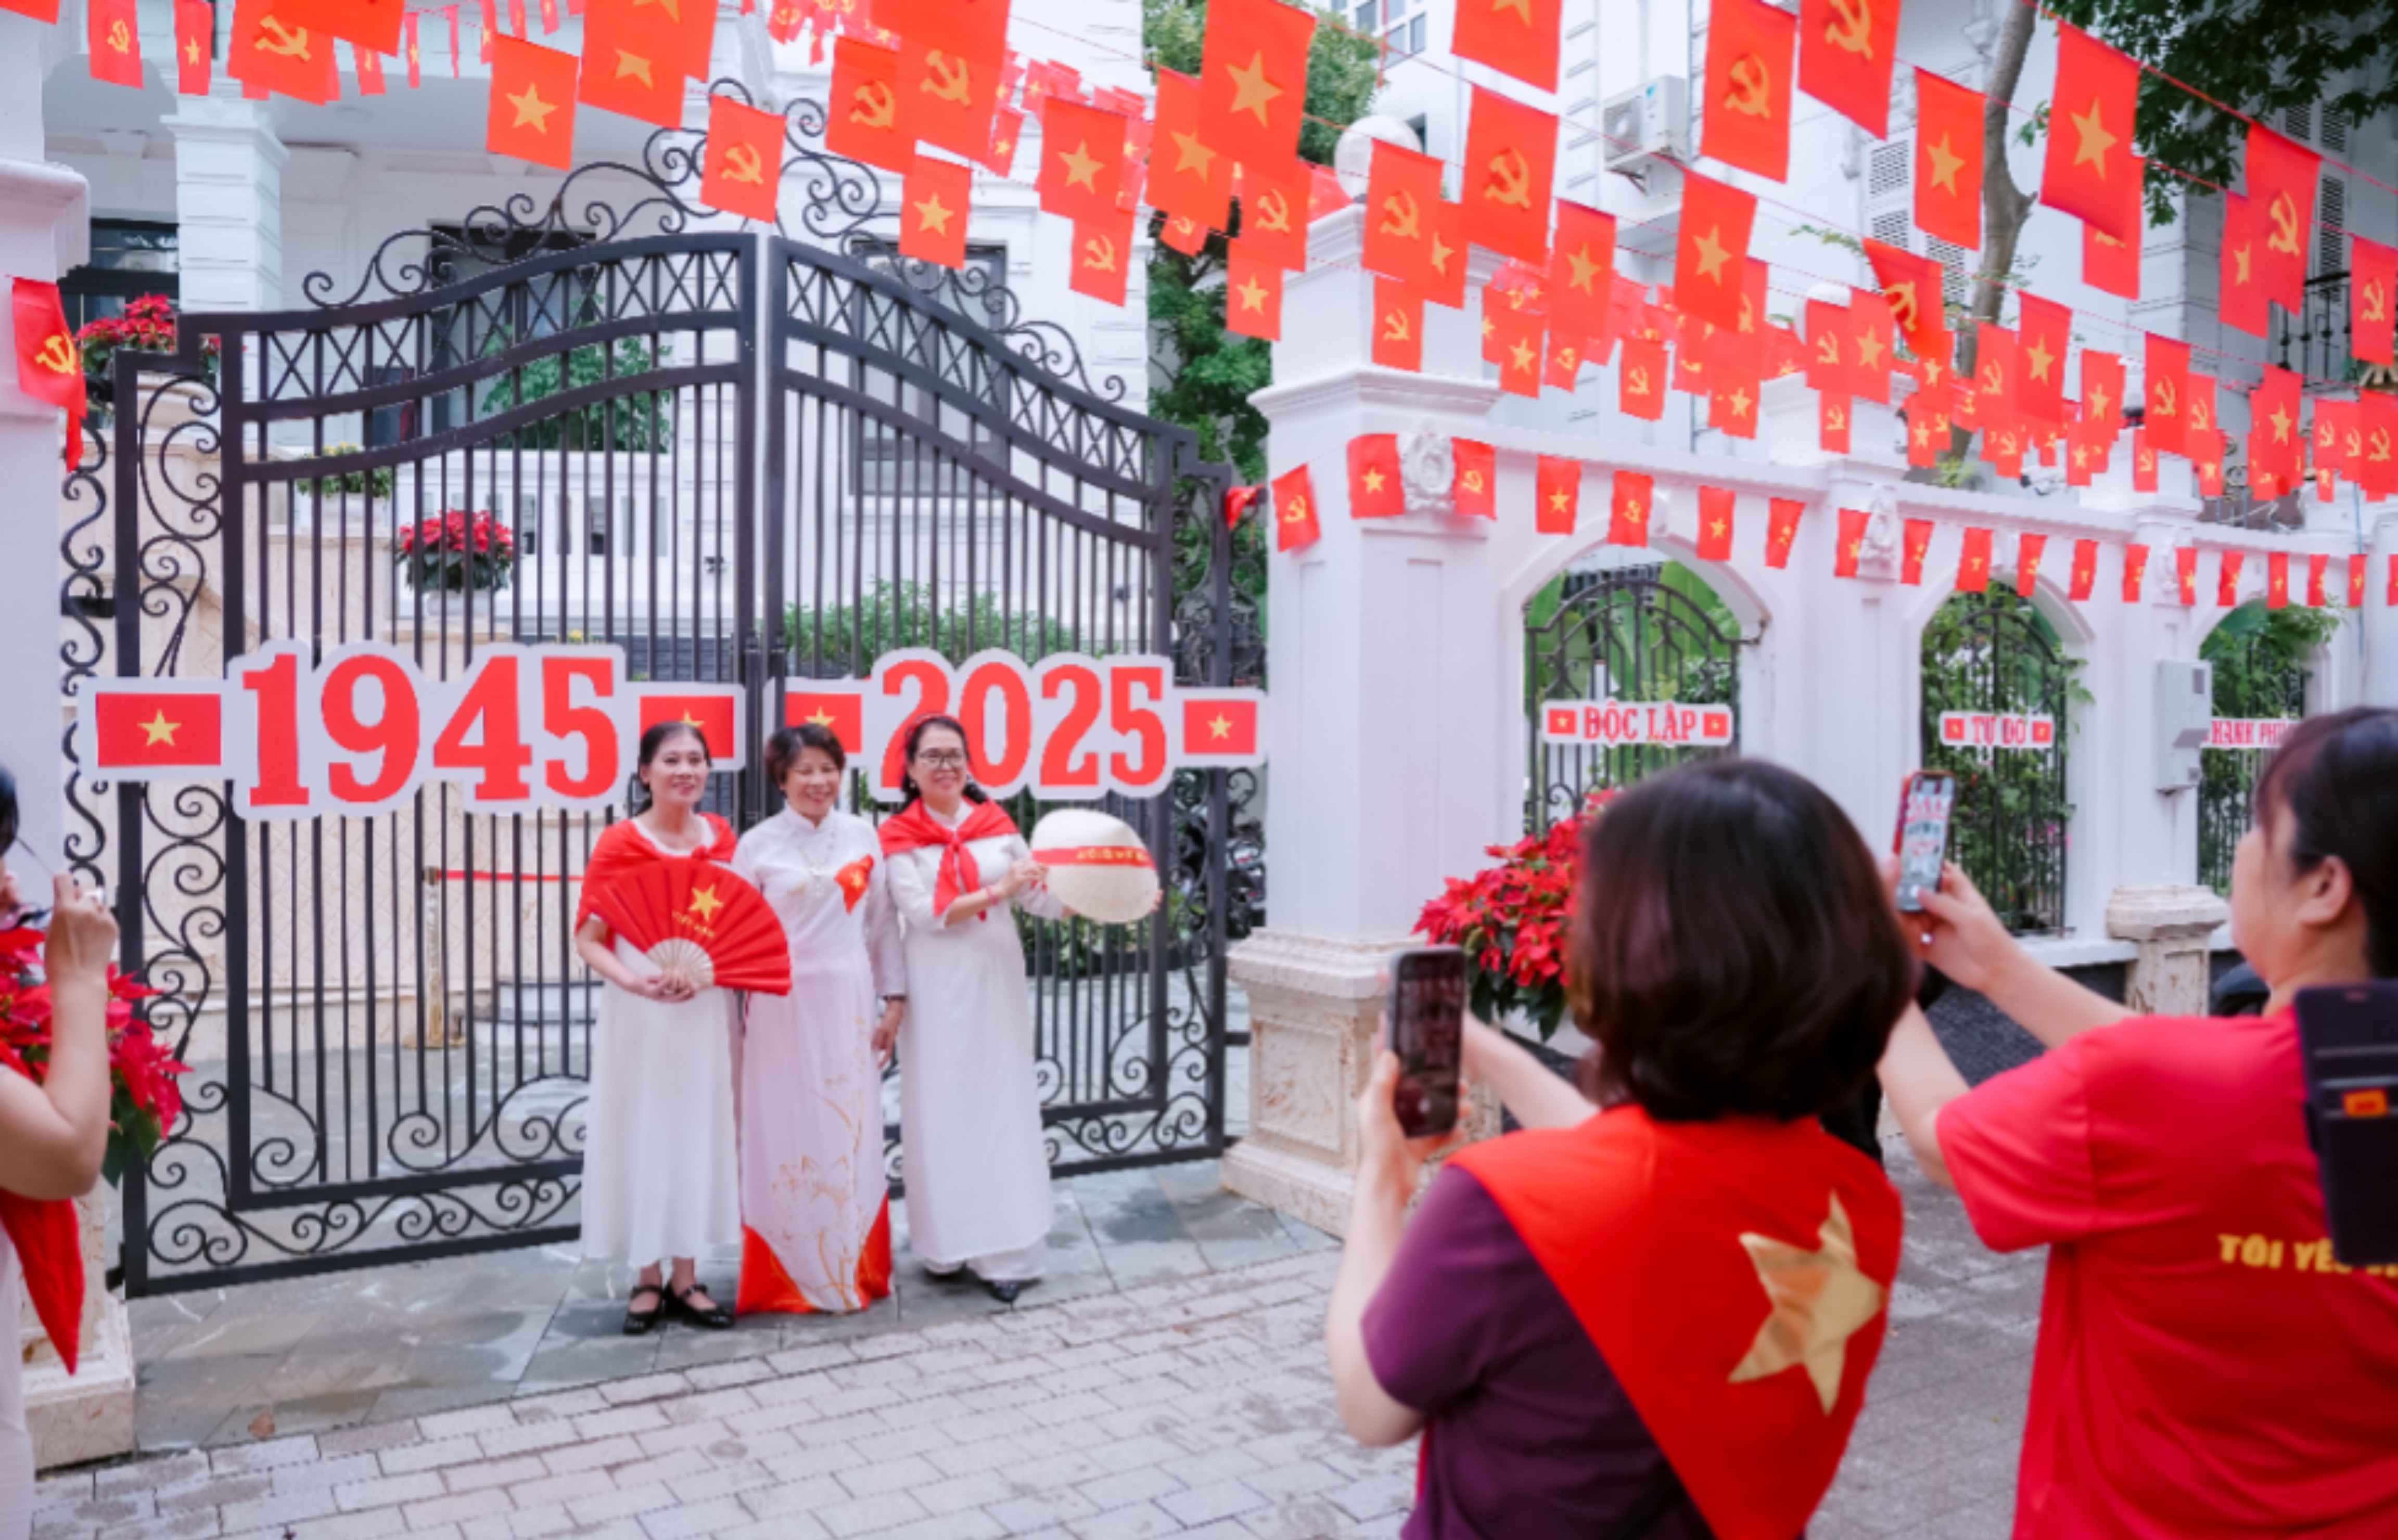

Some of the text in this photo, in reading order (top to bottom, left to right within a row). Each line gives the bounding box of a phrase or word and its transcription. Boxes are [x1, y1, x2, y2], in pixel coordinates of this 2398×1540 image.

[243, 653, 1166, 806] 1945 2025
[1583, 701, 1697, 743] ĐỘC LẬP
[2002, 717, 2026, 745] DO
[2218, 1234, 2284, 1268] TÔI
